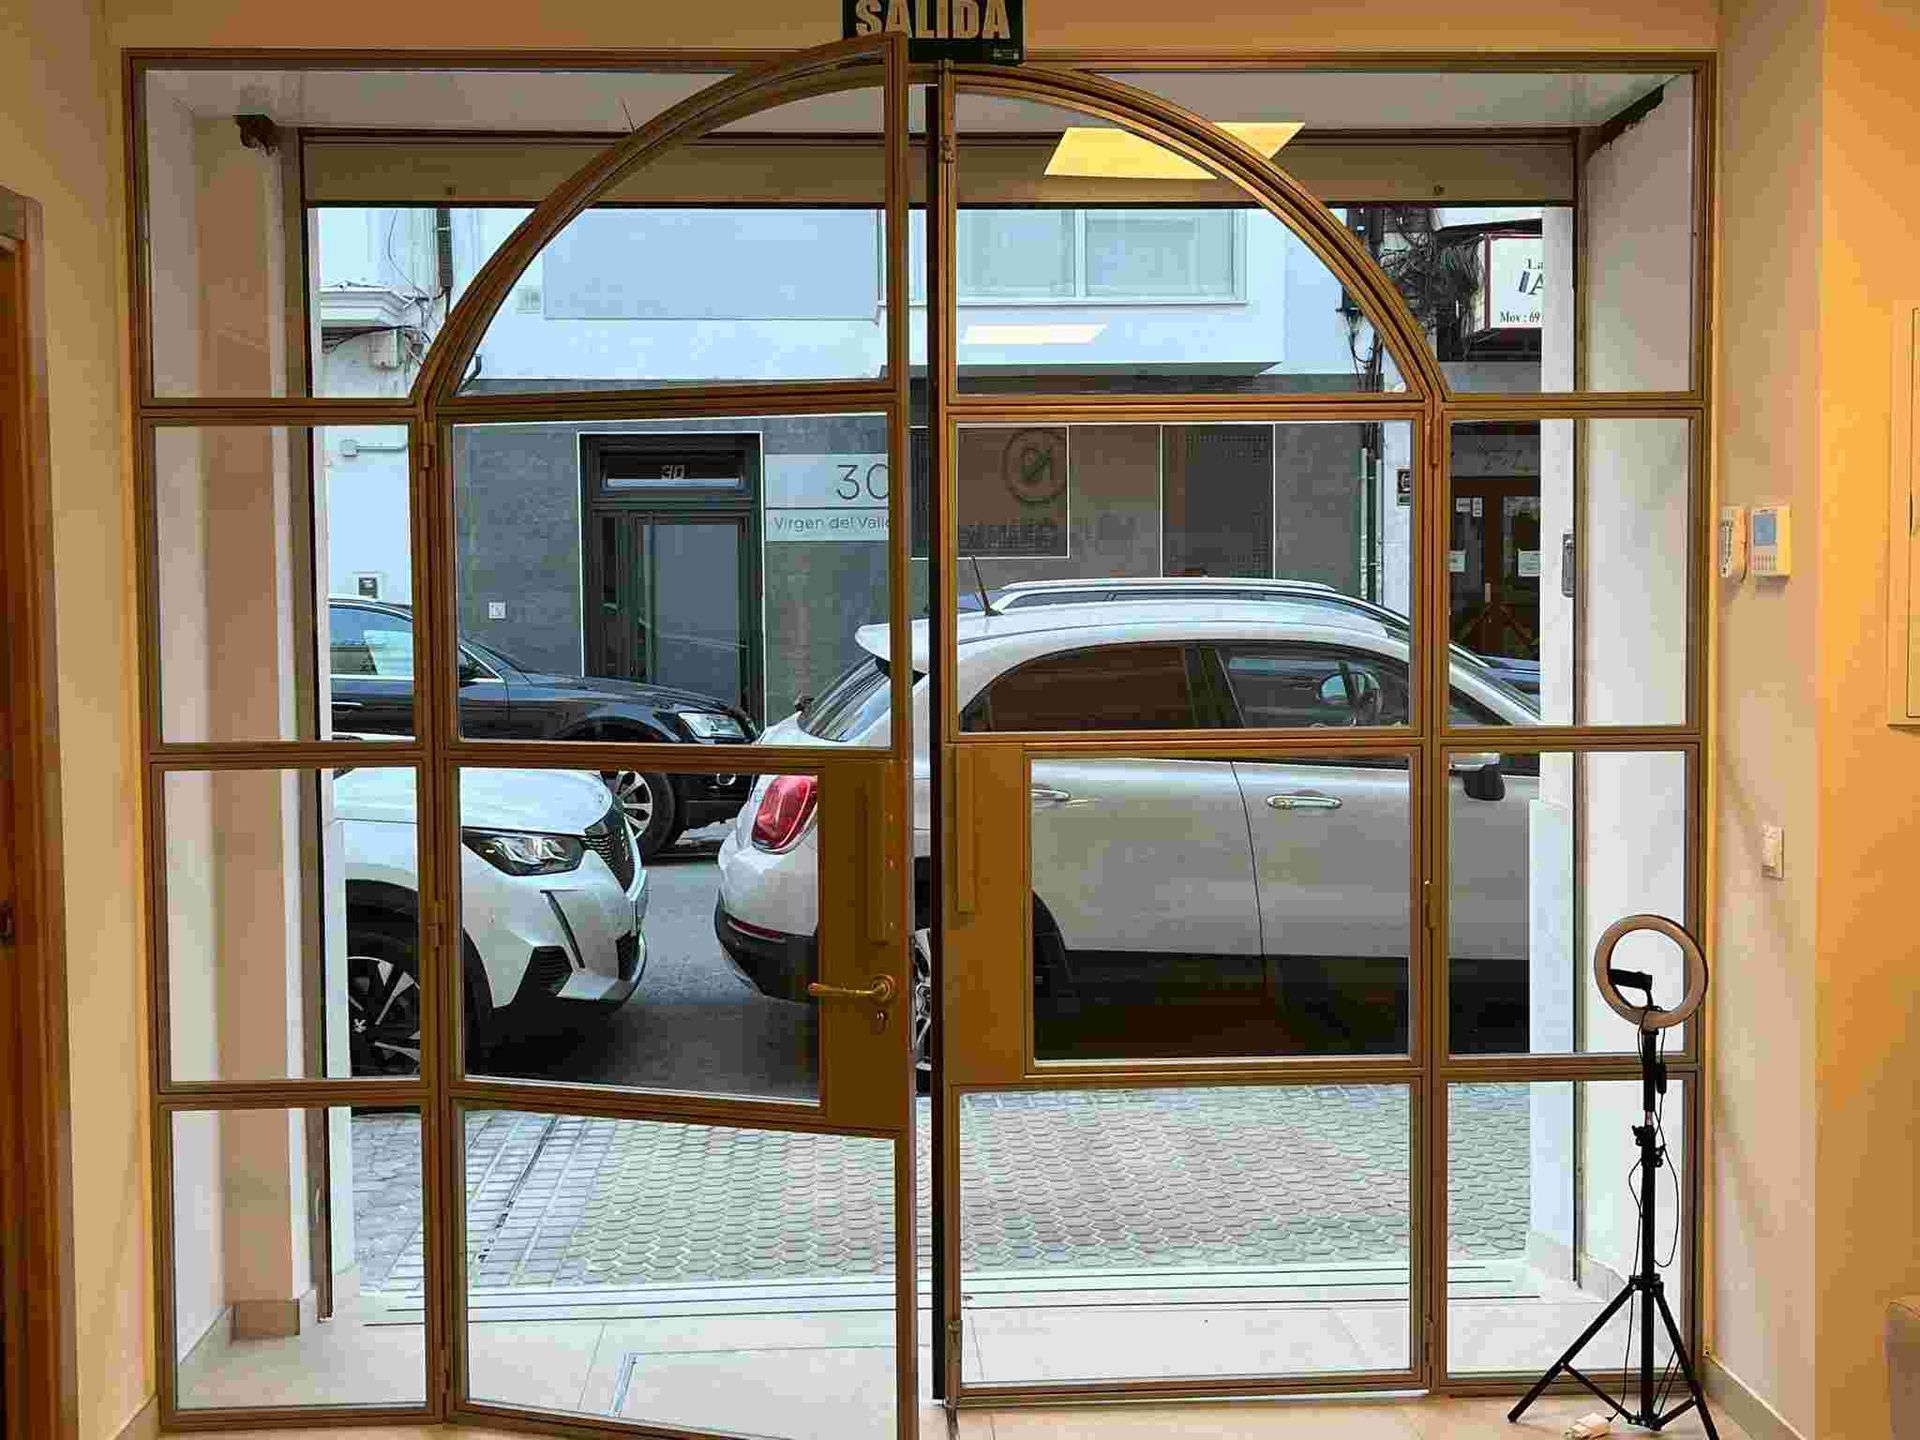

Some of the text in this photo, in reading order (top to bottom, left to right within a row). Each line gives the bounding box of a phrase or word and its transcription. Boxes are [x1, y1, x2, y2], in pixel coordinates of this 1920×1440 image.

[856, 0, 1010, 39] SALIDA
[1529, 311, 1544, 323] 69
[836, 463, 889, 500] 30
[774, 517, 823, 533] Virgen
[829, 517, 853, 529] del
